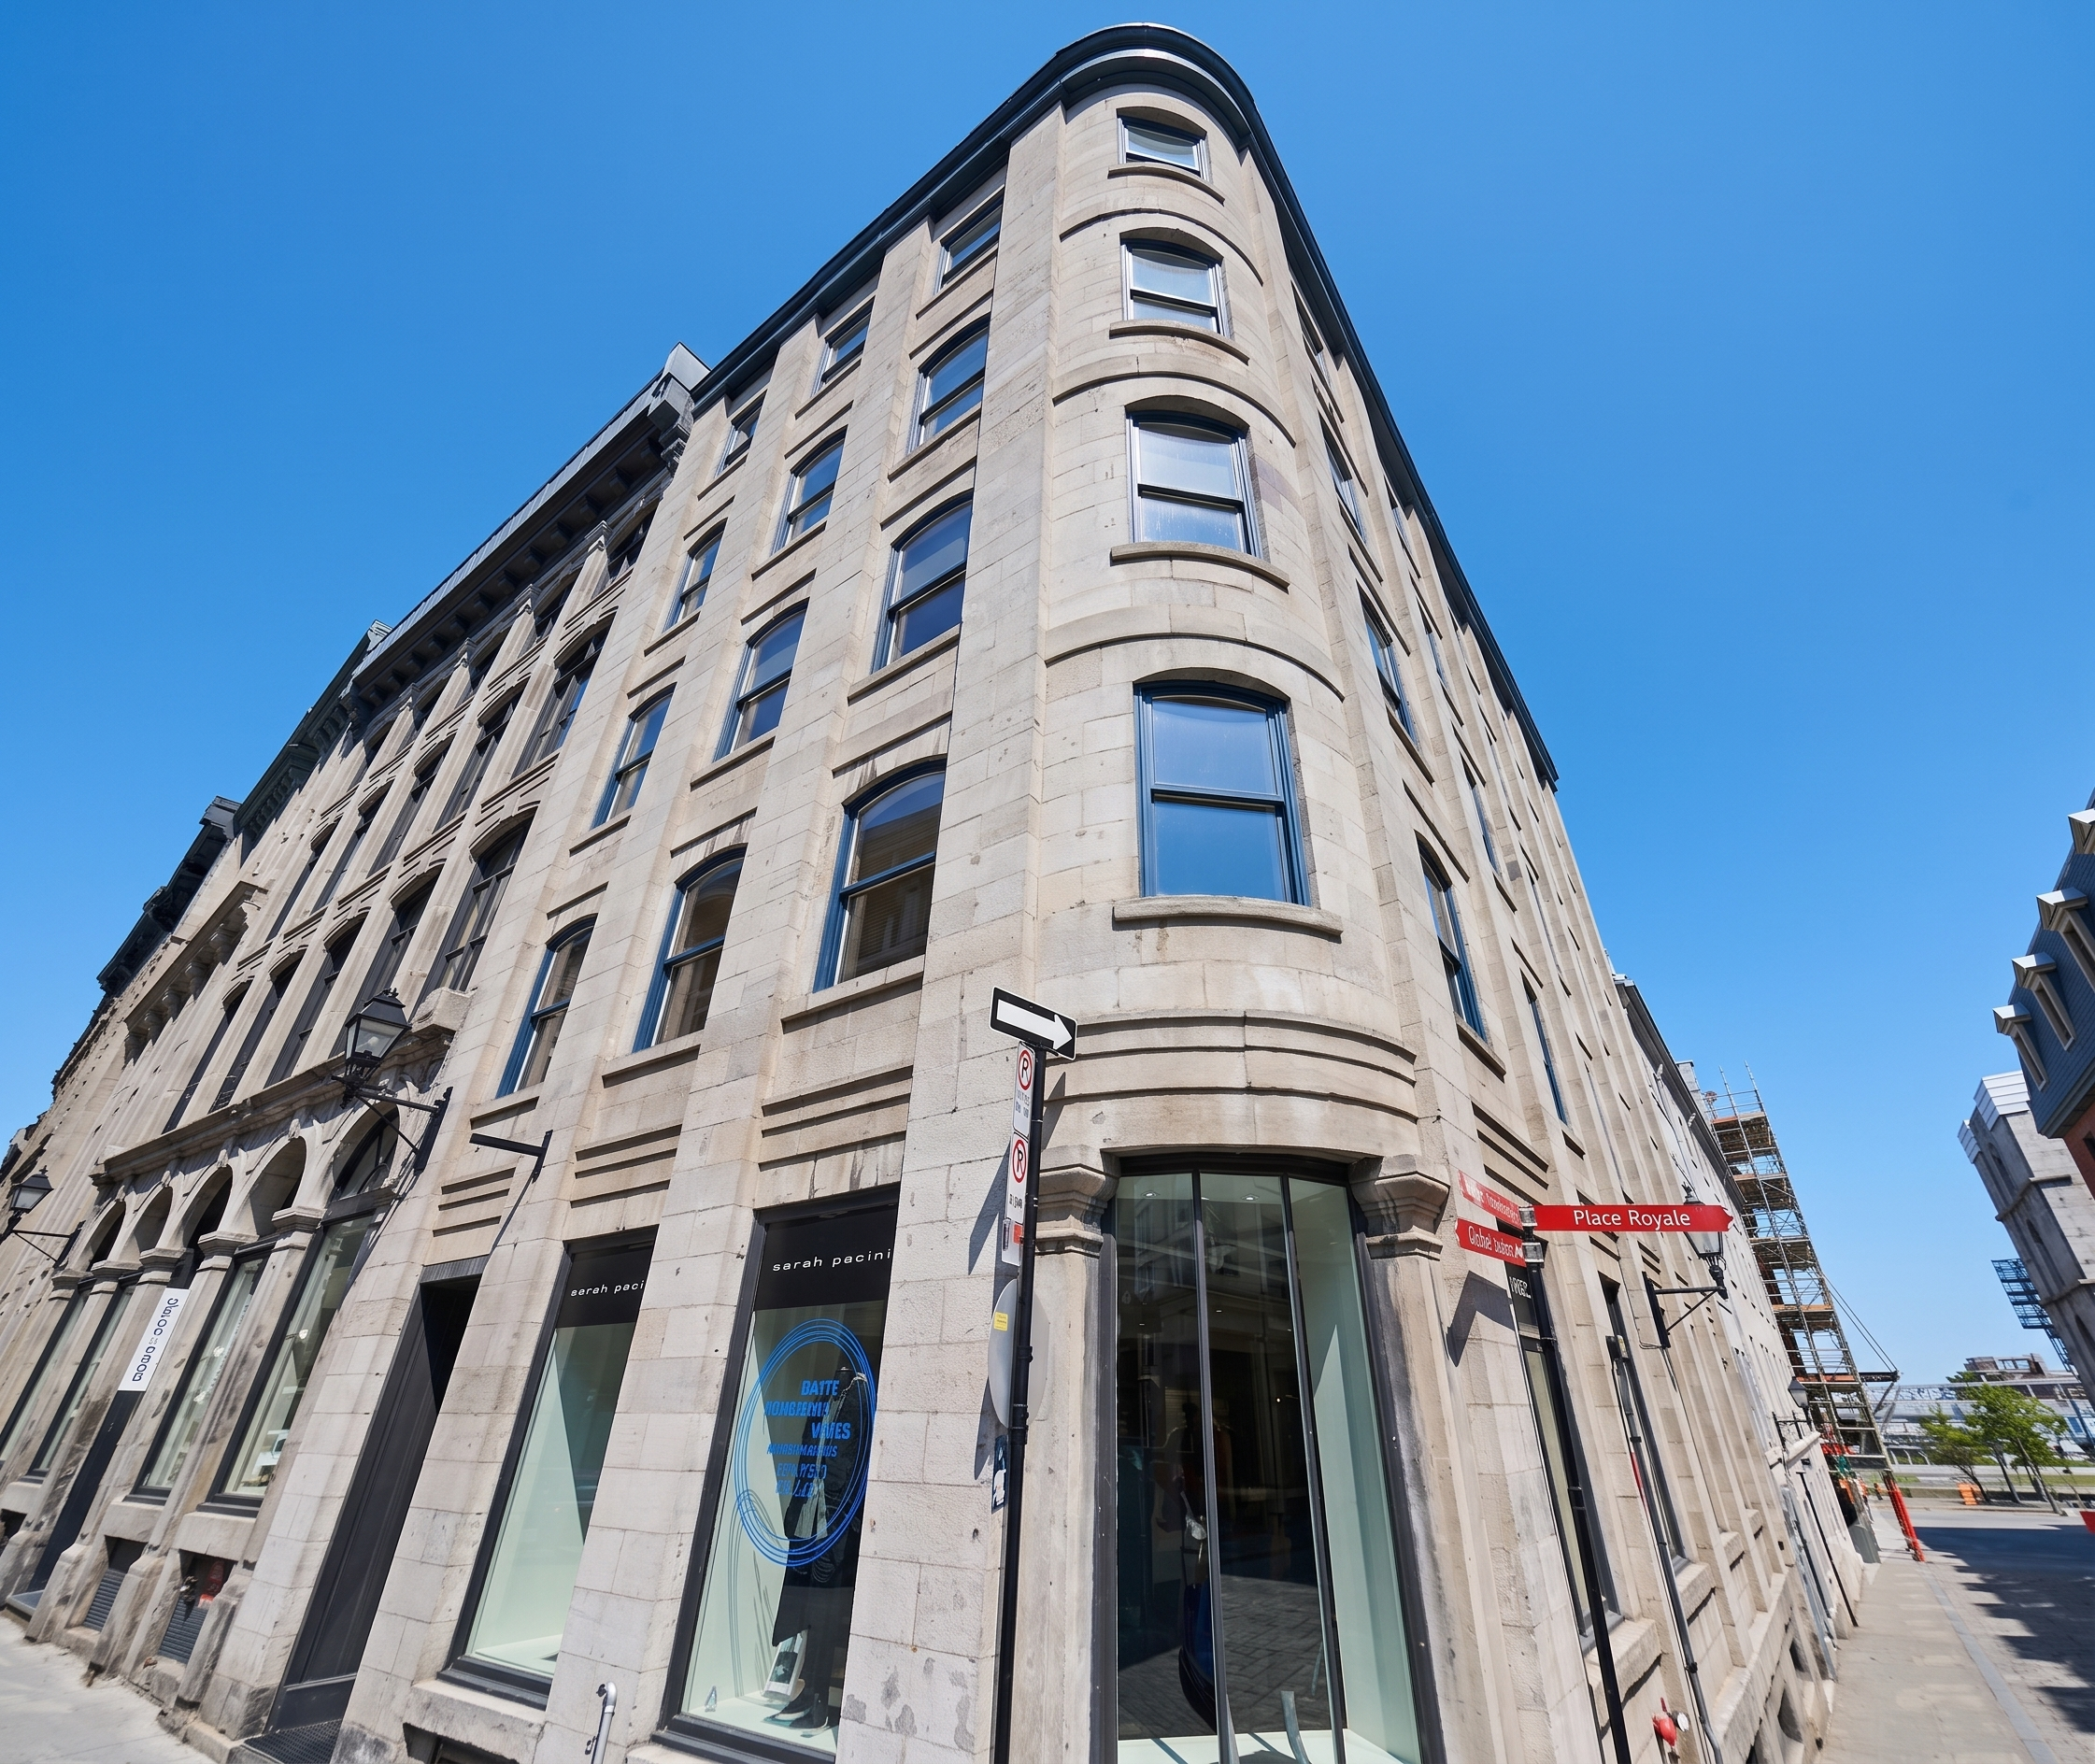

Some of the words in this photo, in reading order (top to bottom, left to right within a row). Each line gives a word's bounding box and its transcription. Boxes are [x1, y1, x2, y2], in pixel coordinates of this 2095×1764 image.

[1574, 1209, 1622, 1226] Place
[1628, 1209, 1691, 1231] Royale
[772, 1256, 823, 1272] sarah
[832, 1248, 891, 1268] pacini
